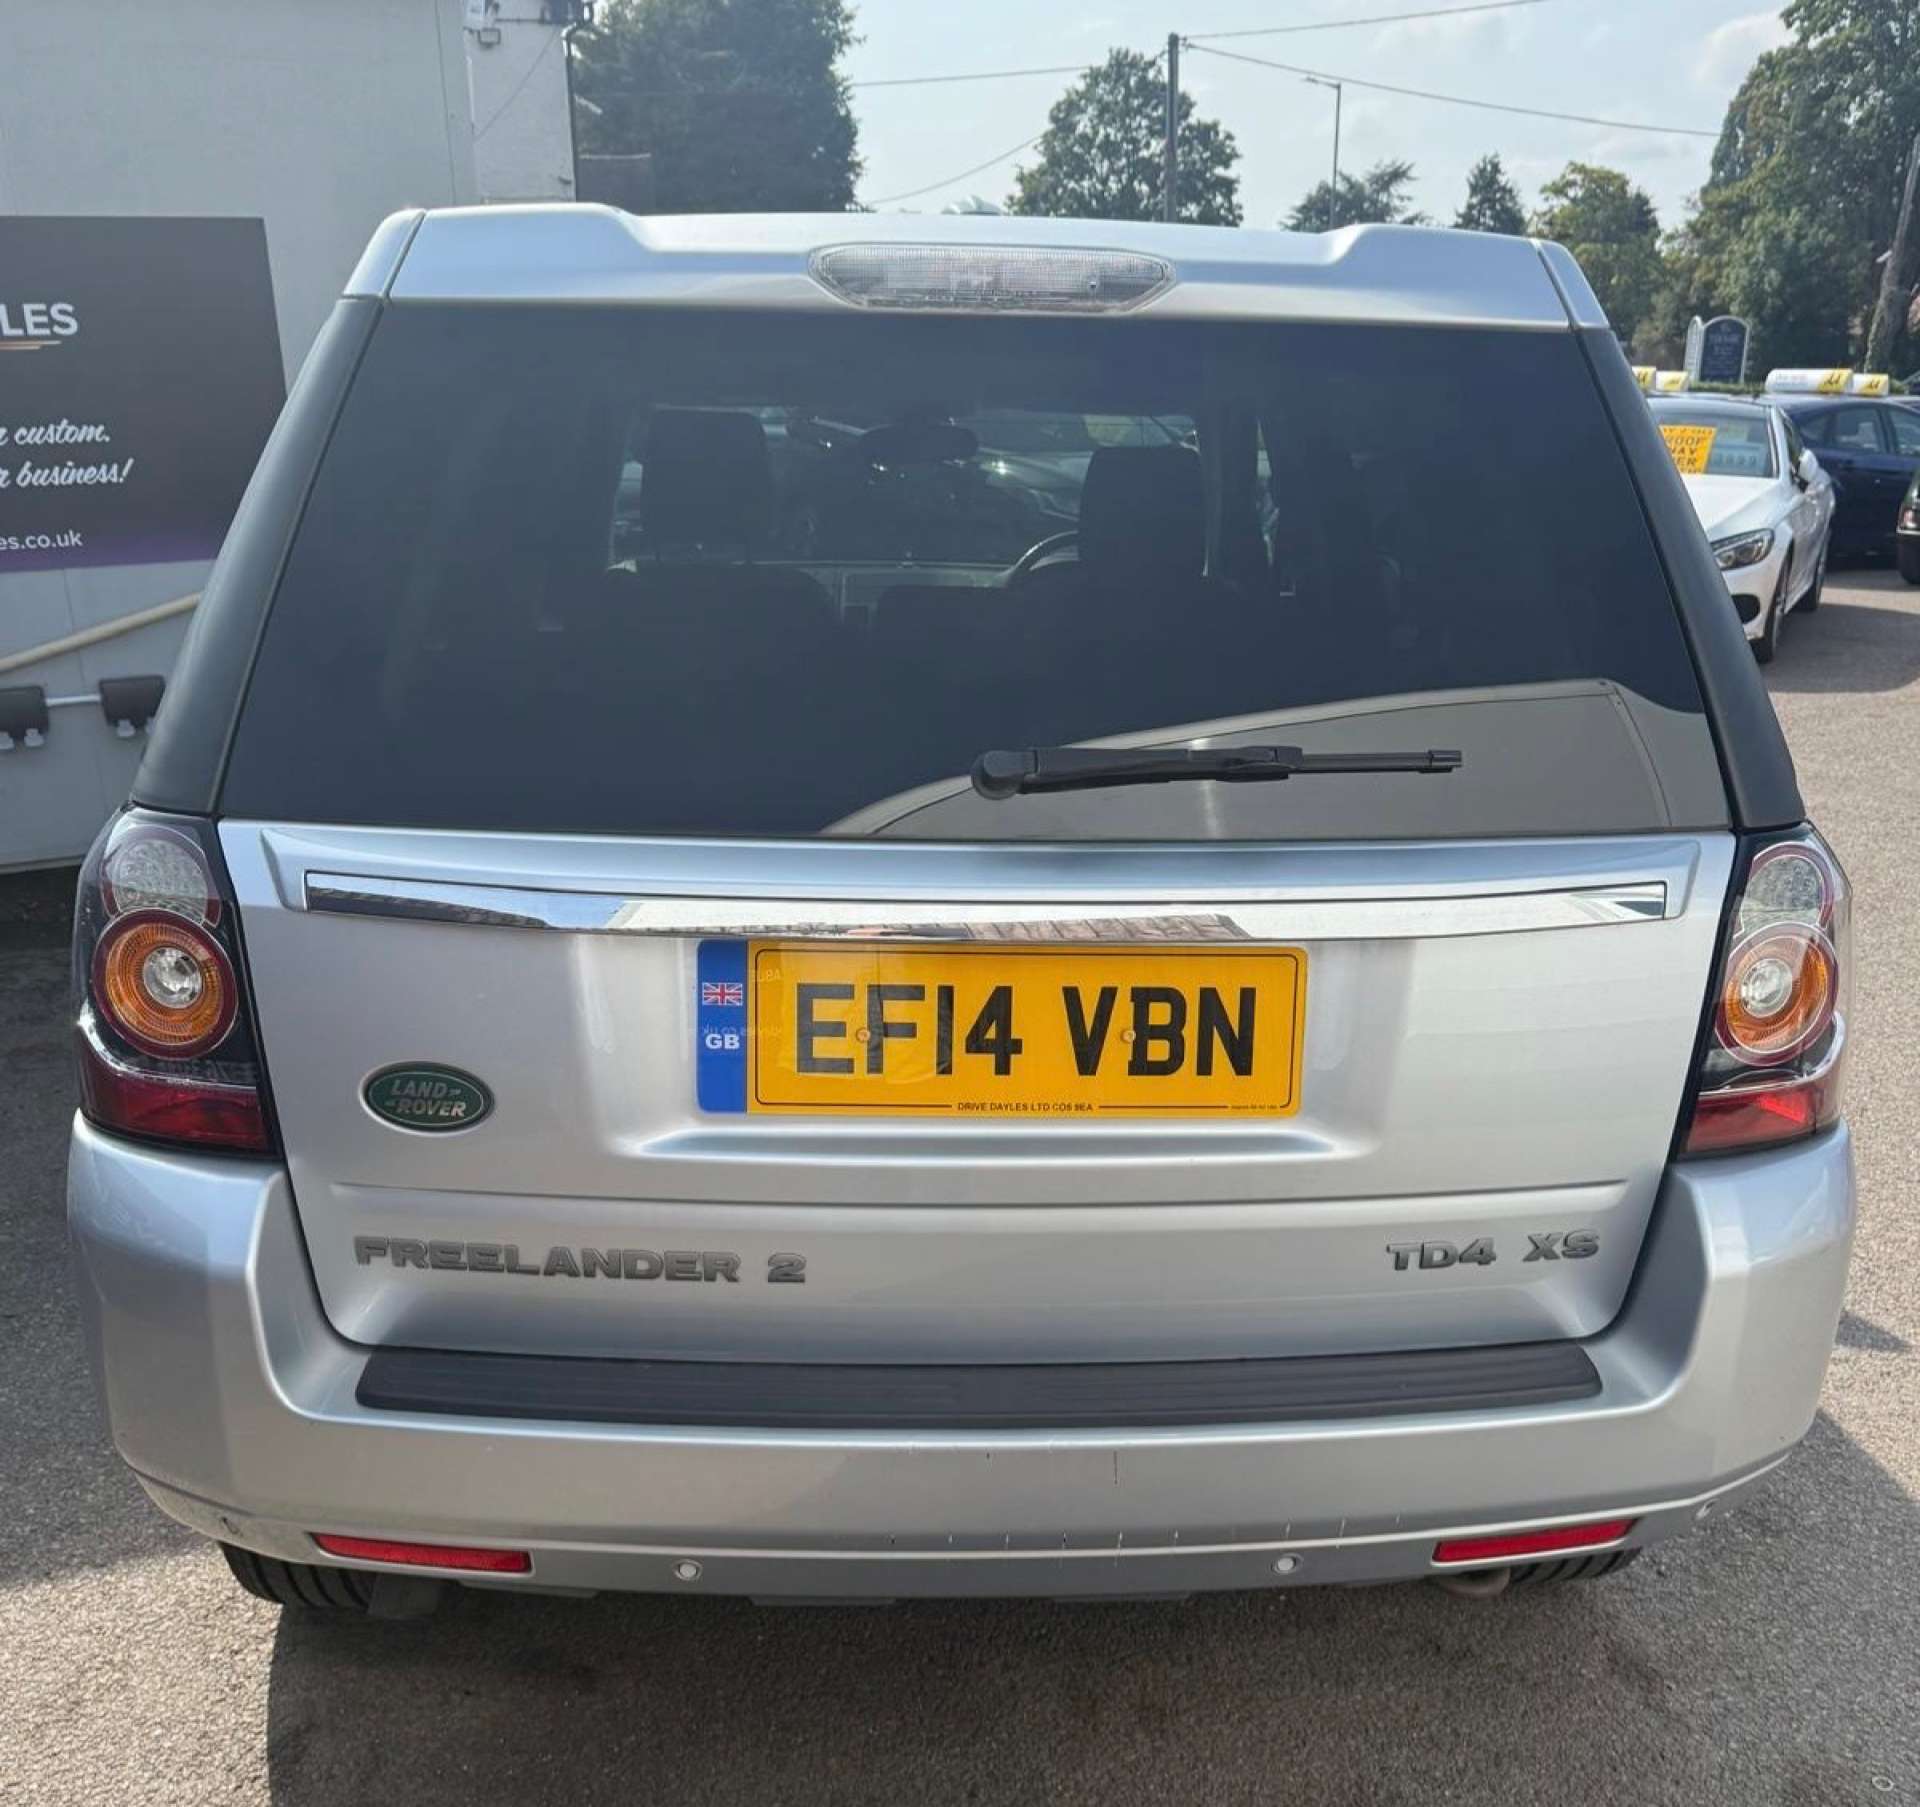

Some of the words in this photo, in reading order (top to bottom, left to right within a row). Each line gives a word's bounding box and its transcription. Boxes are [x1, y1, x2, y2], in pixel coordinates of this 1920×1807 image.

[14, 418, 110, 445] custom.
[16, 457, 134, 487] business!
[705, 1033, 740, 1050] GB
[796, 982, 1023, 1076] EF14
[1063, 985, 1255, 1077] VBN
[391, 1080, 448, 1099] LAND
[397, 1098, 466, 1117] ROVER
[958, 1102, 988, 1112] DRIVE
[990, 1102, 1028, 1112] DAYLES
[1031, 1102, 1050, 1112] LTD
[354, 1236, 741, 1283] FREELANDER
[767, 1251, 806, 1283] 2
[1386, 1237, 1496, 1271] TD4
[1522, 1228, 1599, 1262] XS
